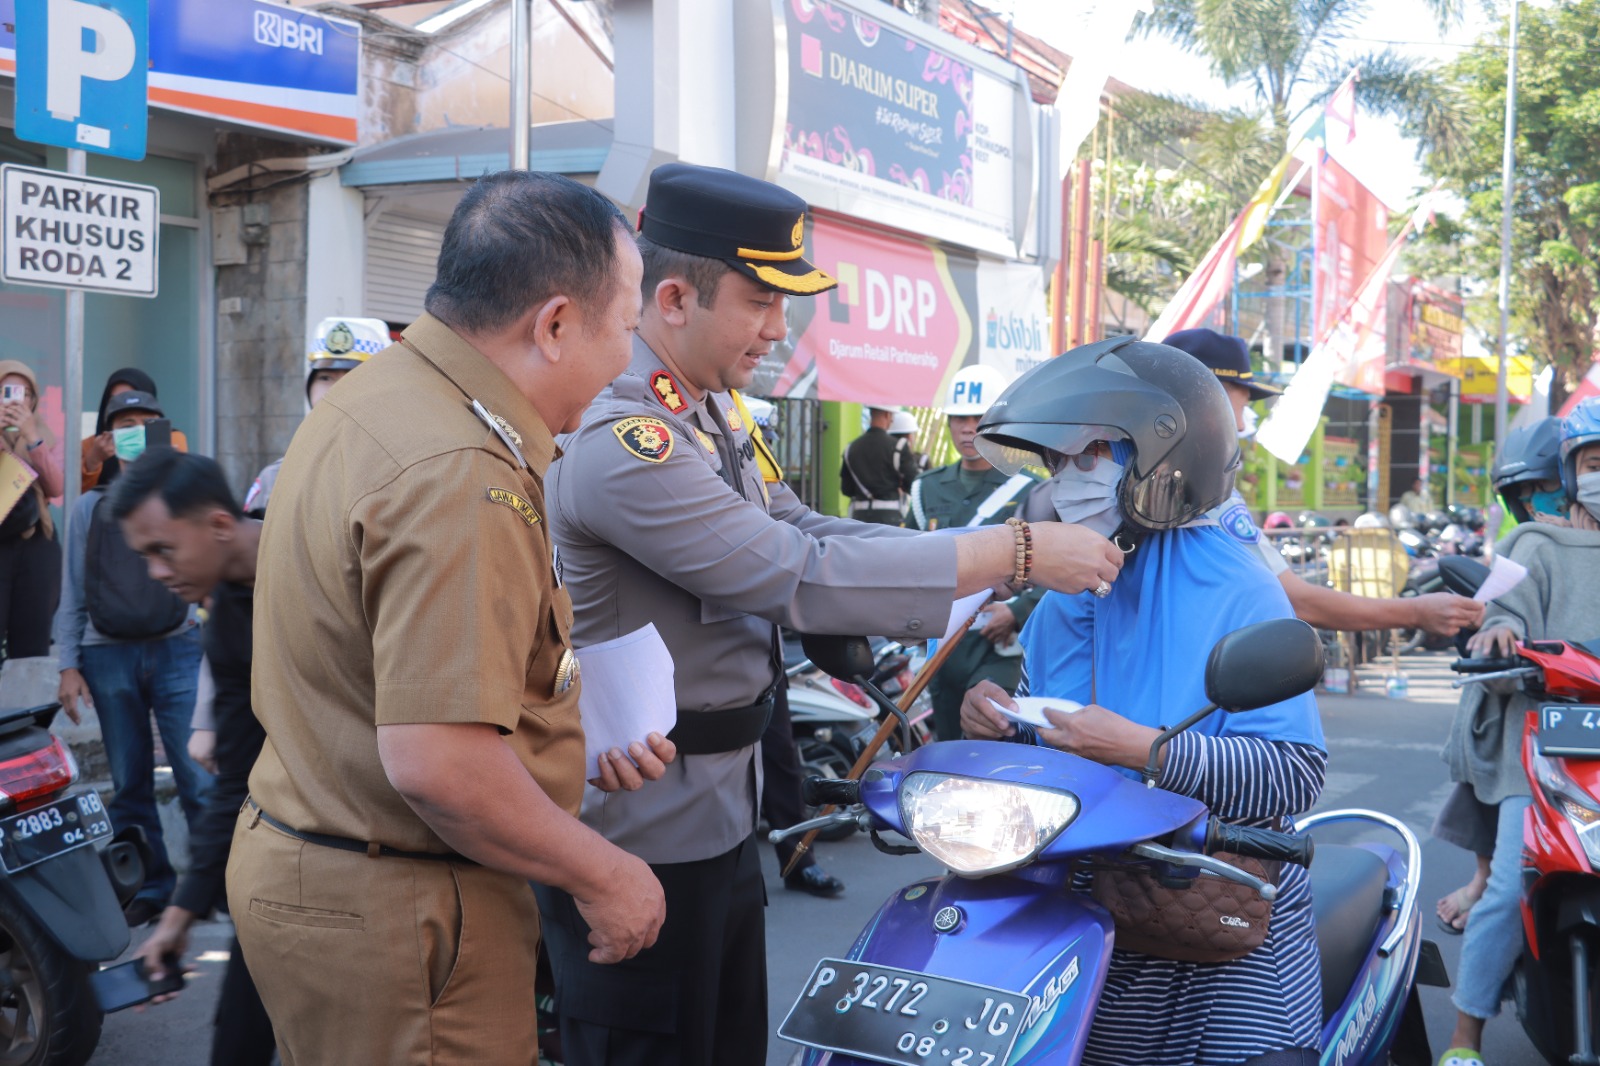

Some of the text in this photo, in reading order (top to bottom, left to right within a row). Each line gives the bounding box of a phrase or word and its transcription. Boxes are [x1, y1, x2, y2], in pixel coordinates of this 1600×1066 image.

[281, 22, 324, 56] BRI
[47, 0, 136, 118] P
[830, 52, 939, 119] DJARUM SUPER
[21, 181, 140, 221] PARKIR
[15, 216, 145, 252] KHUSUS
[20, 247, 132, 281] RODA 2
[865, 268, 937, 337] DRP
[999, 311, 1042, 351] blibli
[829, 338, 938, 371] Djarum Retail Partnership
[953, 382, 982, 404] PM
[492, 490, 537, 522] JAWA TIMUR
[1549, 711, 1563, 728] P
[16, 807, 63, 838] 2883
[77, 793, 102, 816] RB
[807, 967, 1015, 1037] P 3272 JG
